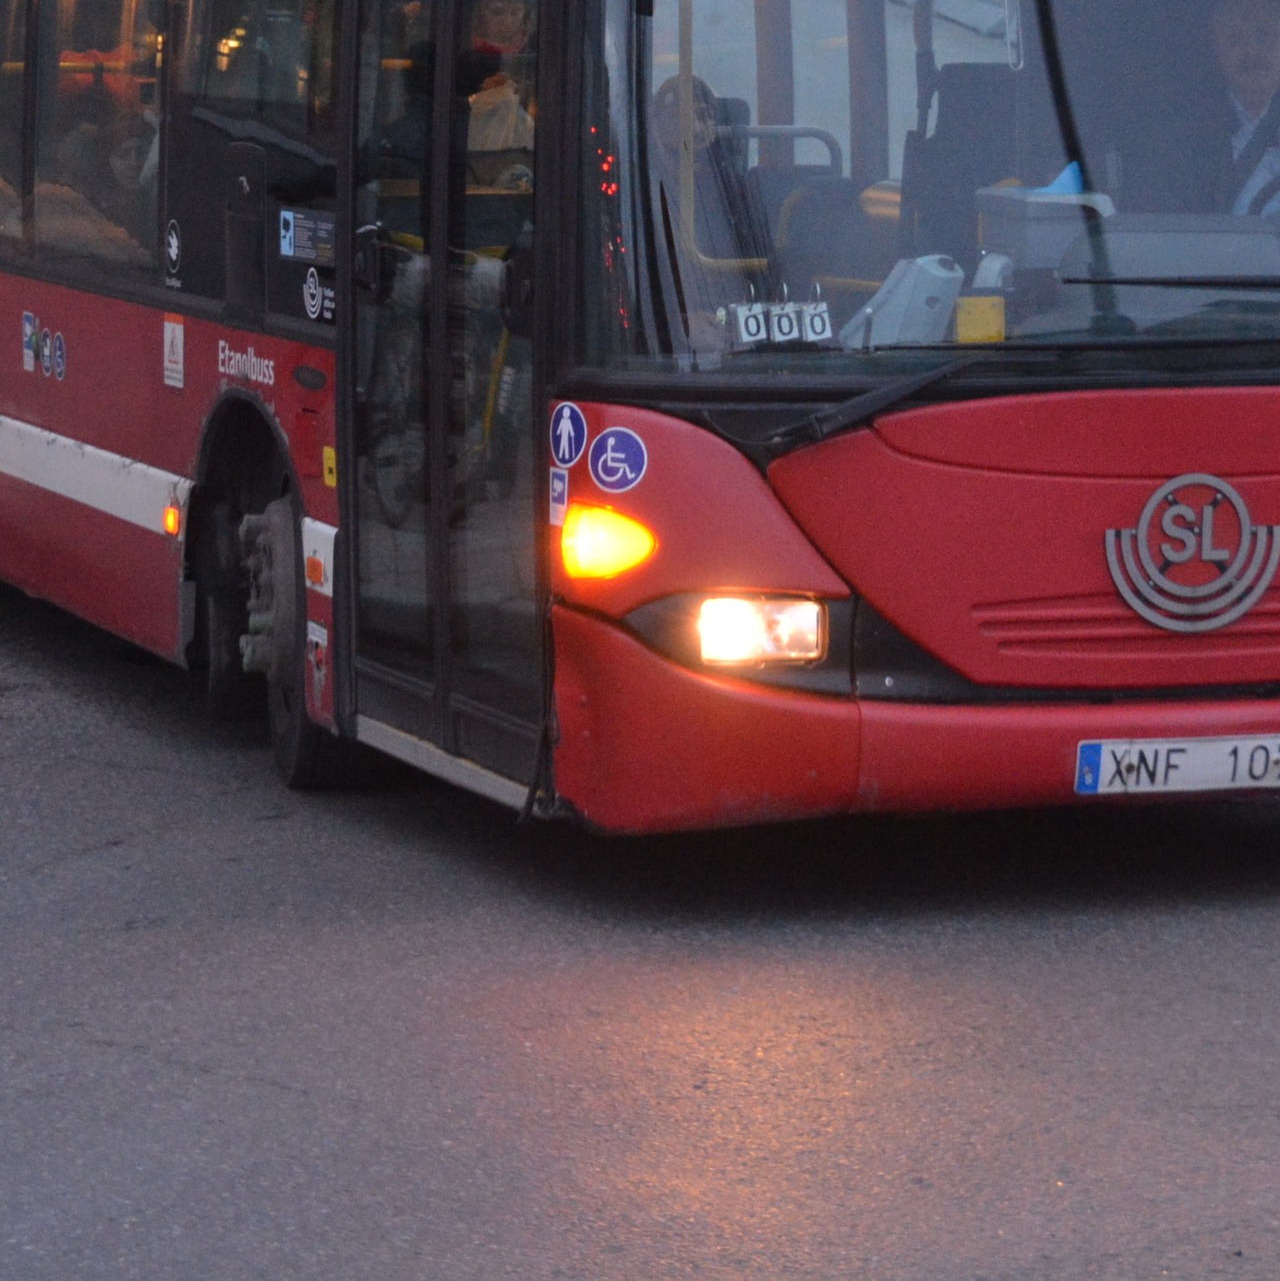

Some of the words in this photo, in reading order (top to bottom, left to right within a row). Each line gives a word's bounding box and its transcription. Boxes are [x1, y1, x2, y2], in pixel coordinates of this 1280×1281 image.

[218, 339, 275, 386] Etanolbuss
[1160, 504, 1230, 563] SL
[1107, 747, 1188, 787] XNF
